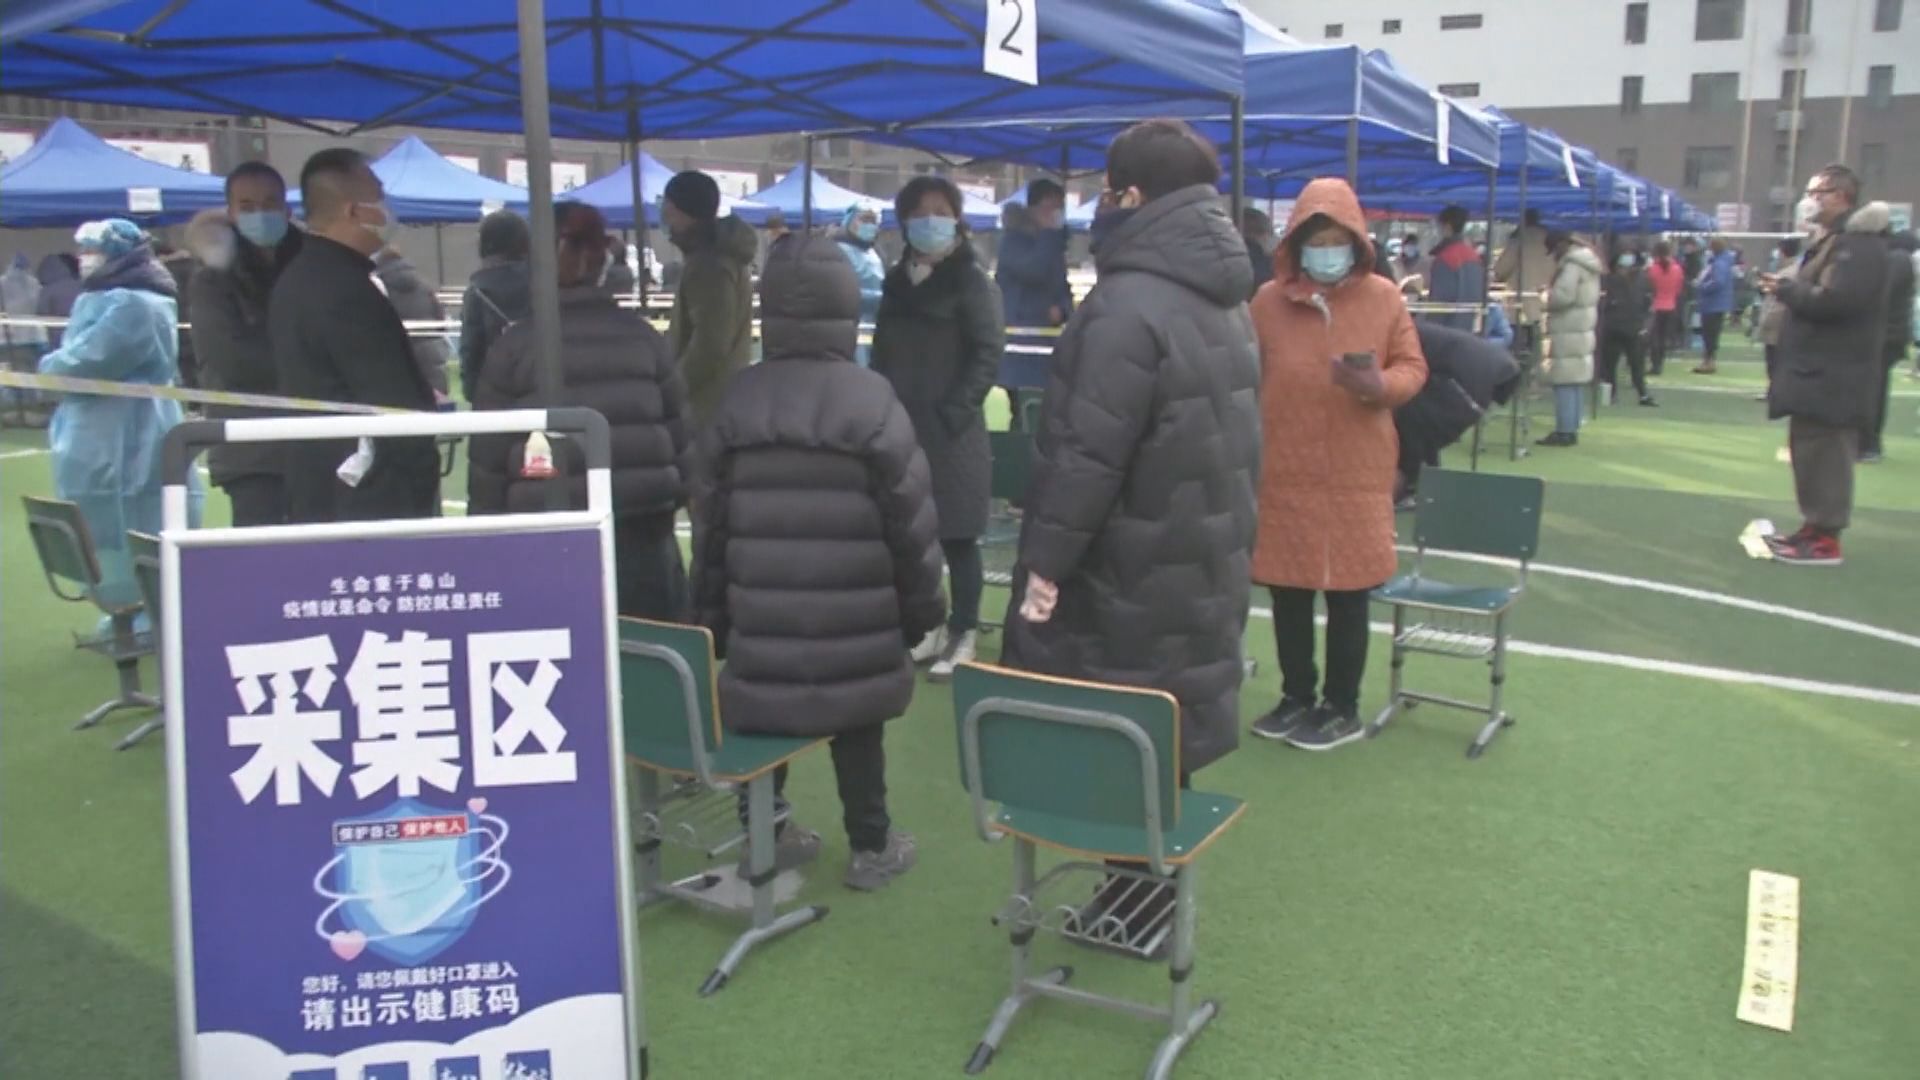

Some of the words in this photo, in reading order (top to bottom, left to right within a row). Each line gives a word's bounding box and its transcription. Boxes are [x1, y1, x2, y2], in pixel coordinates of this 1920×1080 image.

[1000, 0, 1022, 56] 2
[330, 572, 456, 595] 生命重于泰山
[283, 597, 391, 619] 疫情就是命令
[396, 592, 503, 613] 防控就是责任
[224, 628, 578, 806] 采集区
[339, 824, 400, 841] 保护自己
[403, 820, 464, 836] 保护他人
[301, 983, 521, 1031] 请出示健康码
